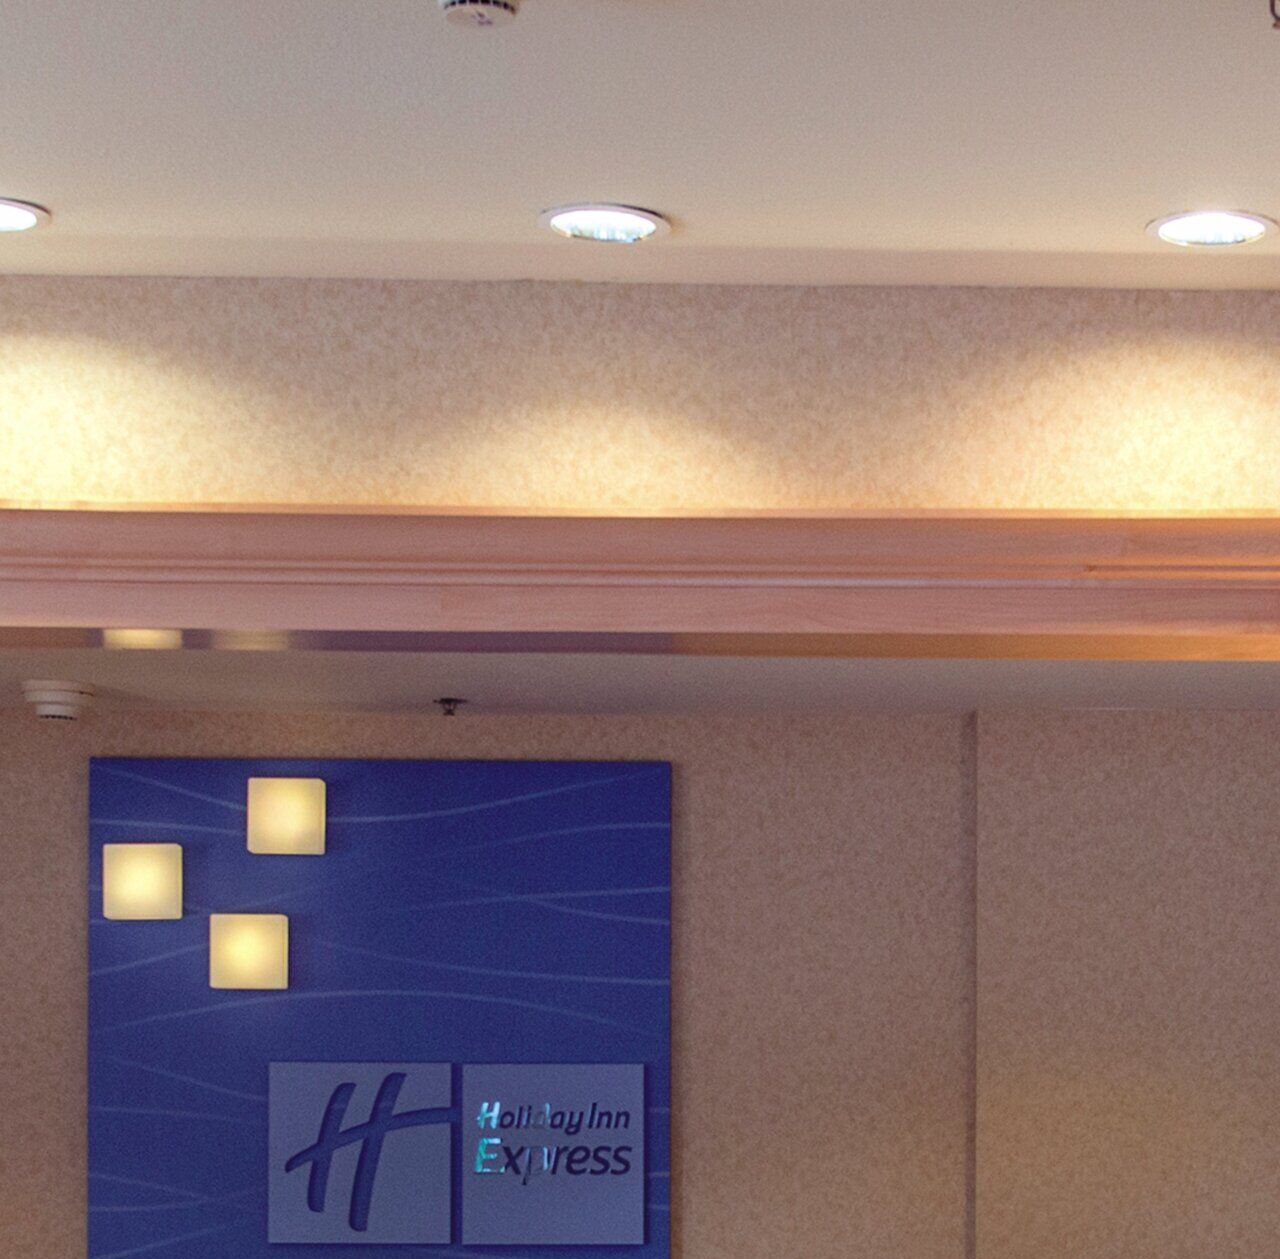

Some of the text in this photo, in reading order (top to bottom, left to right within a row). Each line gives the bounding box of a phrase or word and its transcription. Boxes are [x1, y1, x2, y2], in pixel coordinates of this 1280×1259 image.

[477, 1101, 631, 1135] Holiday Inn
[474, 1137, 633, 1185] Express
